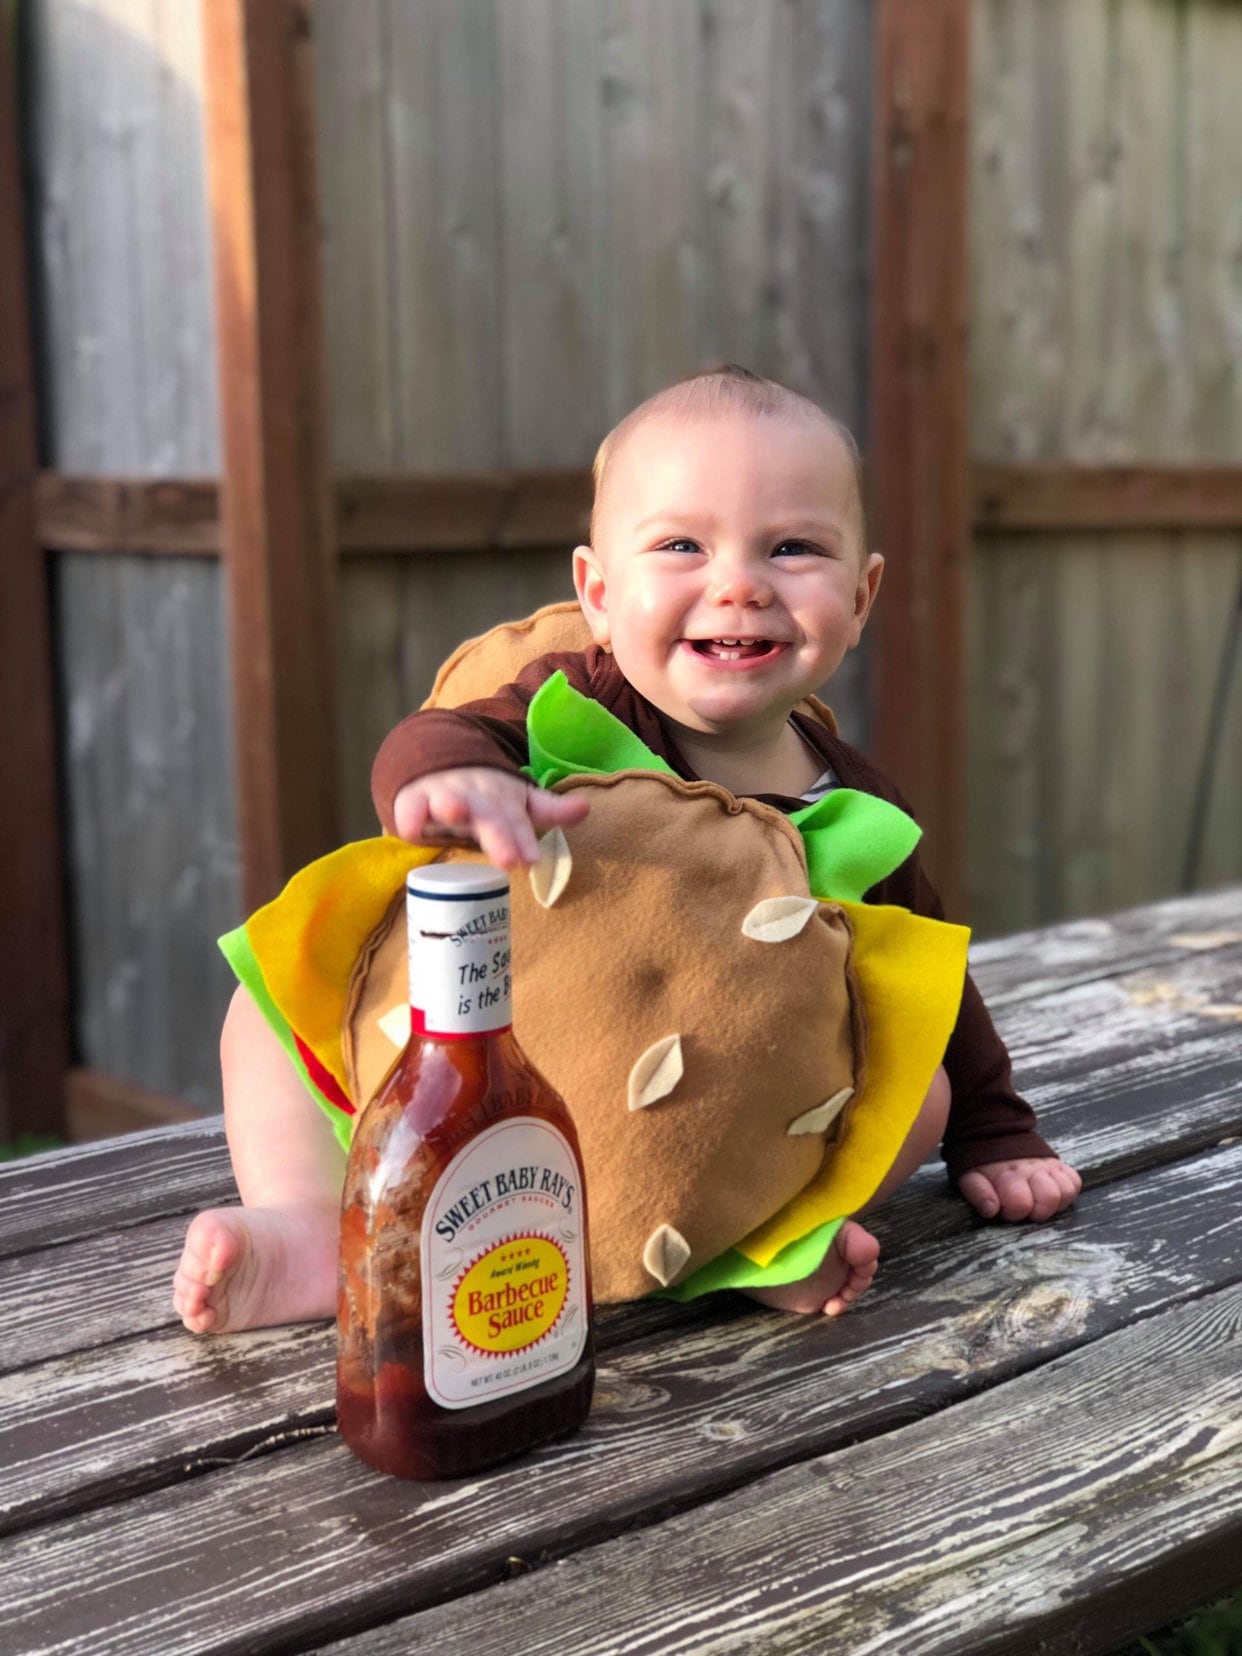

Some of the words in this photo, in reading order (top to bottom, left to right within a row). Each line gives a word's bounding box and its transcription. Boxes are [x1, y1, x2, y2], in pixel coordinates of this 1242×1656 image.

[450, 913, 487, 948] SWEET
[488, 907, 509, 924] BAB
[458, 962, 487, 985] The
[458, 995, 472, 1015] is
[478, 986, 500, 1010] the
[435, 1181, 492, 1243] SWEET
[495, 1166, 540, 1196] BABY
[540, 1168, 576, 1209] RAY'S
[468, 1272, 558, 1316] Barbecue
[488, 1300, 545, 1339] Sauce
